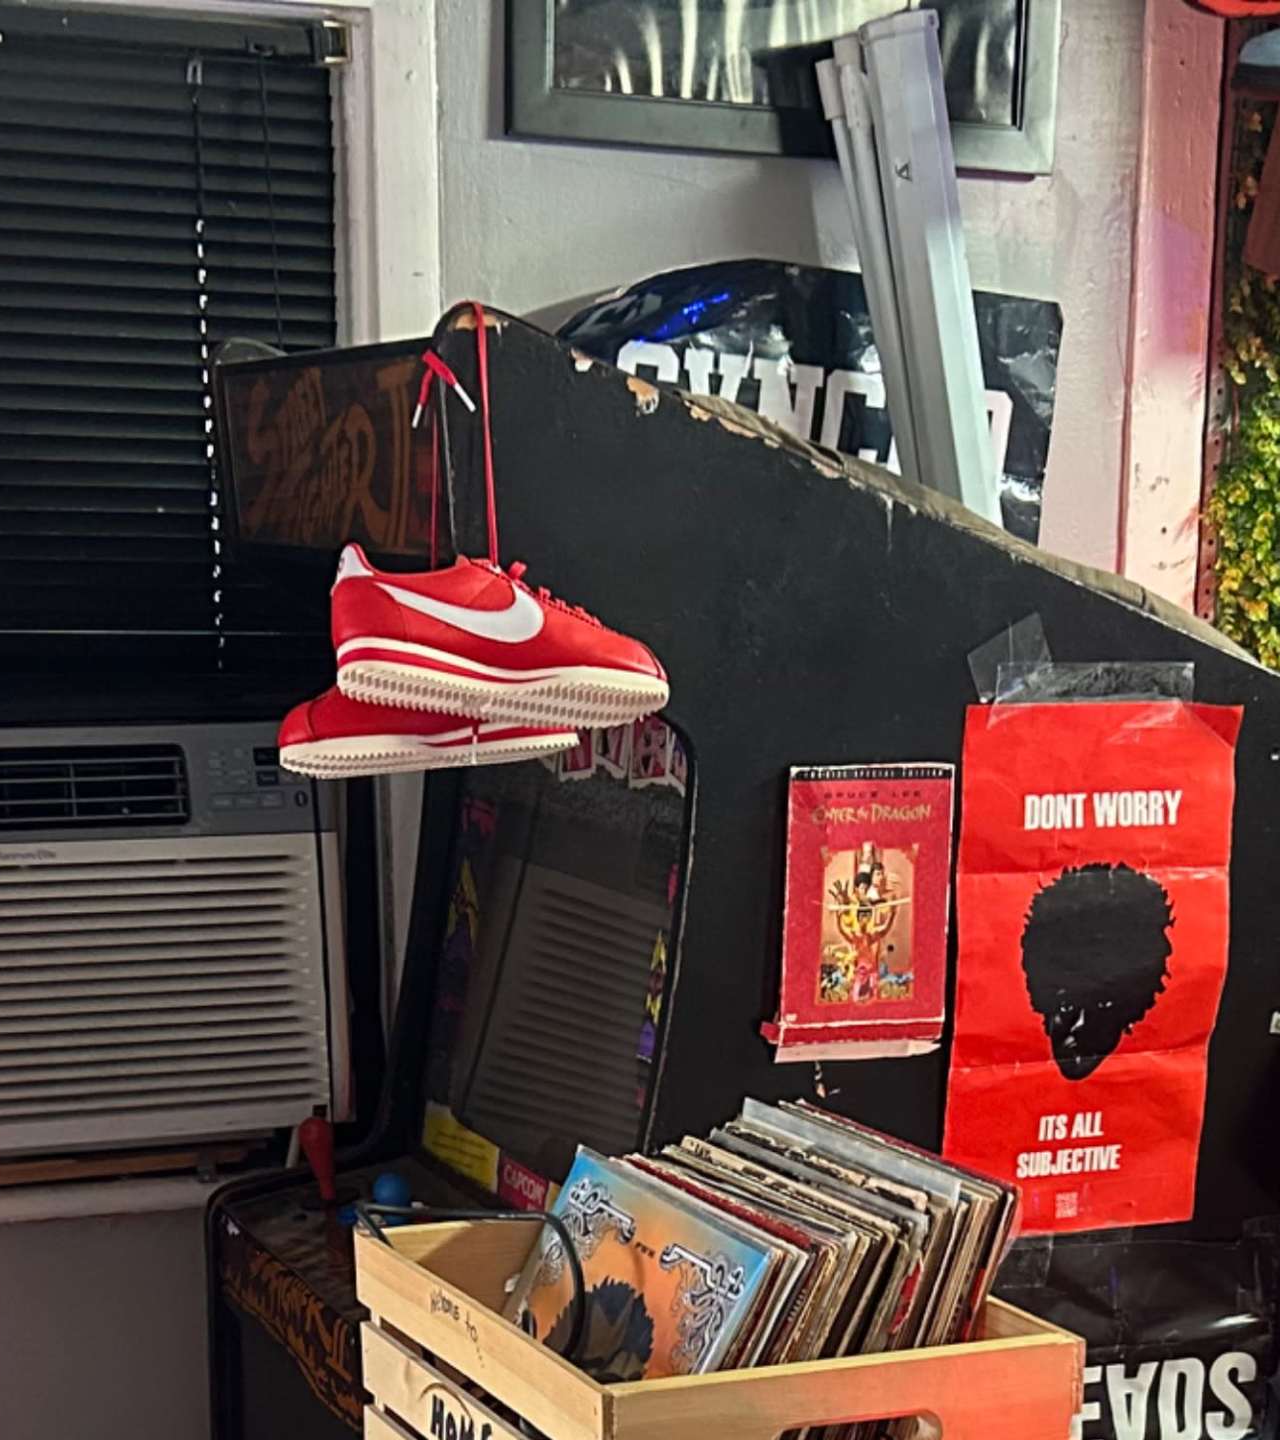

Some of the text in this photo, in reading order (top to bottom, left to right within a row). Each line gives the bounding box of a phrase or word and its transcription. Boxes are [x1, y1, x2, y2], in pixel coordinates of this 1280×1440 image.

[1023, 789, 1183, 831] DONT WORRY
[1038, 1110, 1105, 1142] ITS ALL
[1016, 1143, 1123, 1179] SUBJECTIVE
